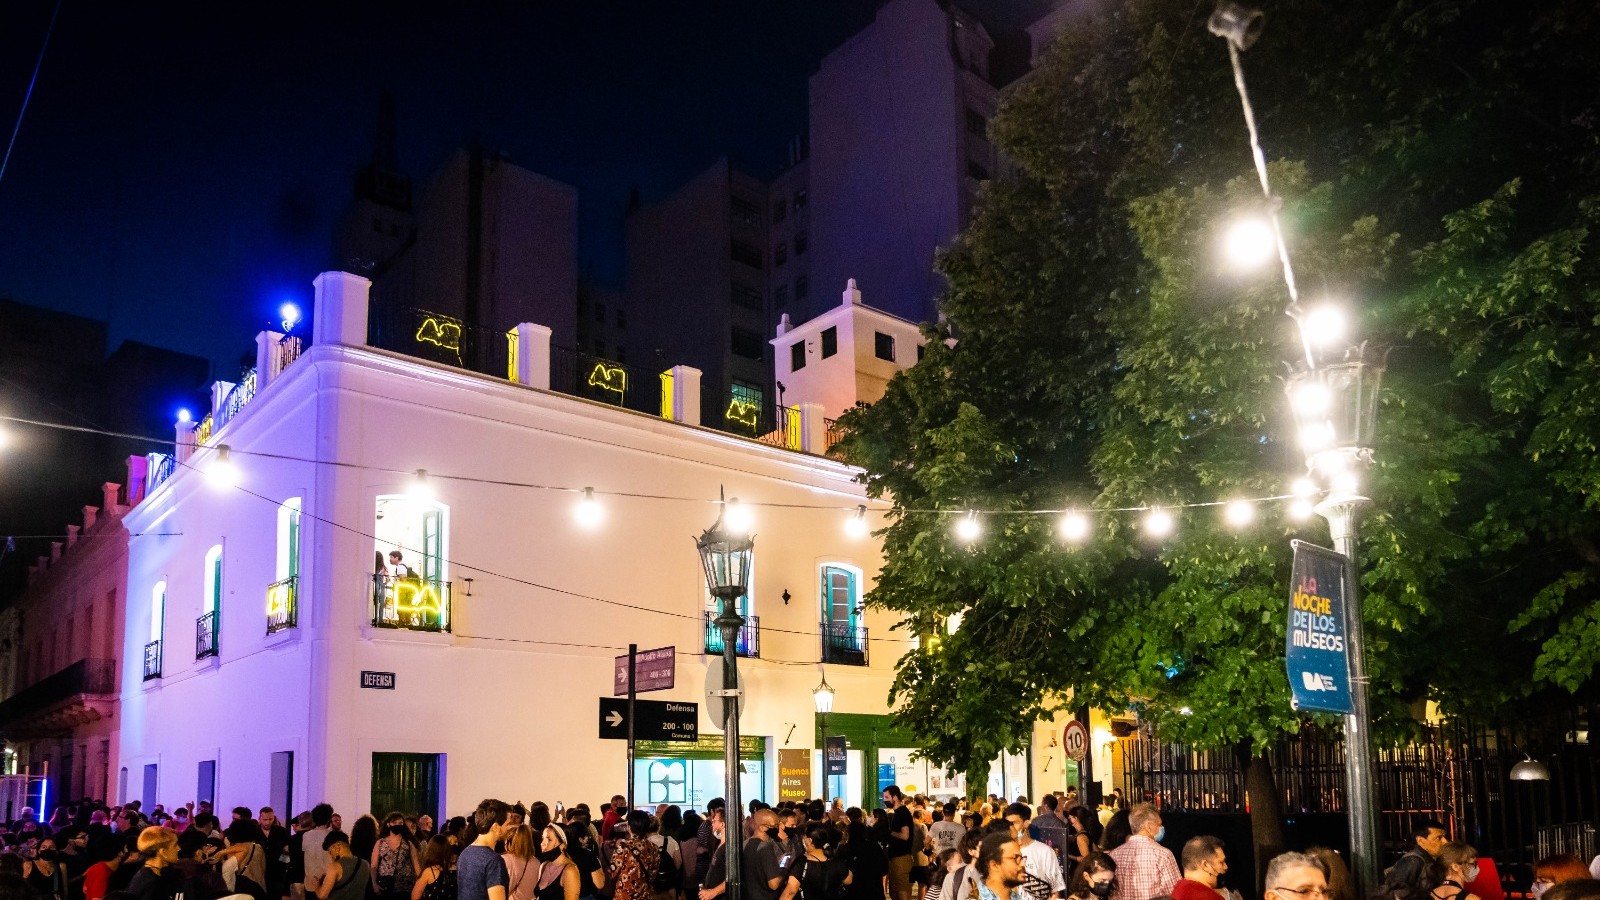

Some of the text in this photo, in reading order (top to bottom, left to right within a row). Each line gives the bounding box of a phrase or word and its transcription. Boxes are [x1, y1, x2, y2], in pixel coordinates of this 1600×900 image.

[1302, 576, 1317, 594] LA
[1293, 584, 1332, 617] NOCHE
[1294, 610, 1336, 632] DE LOS
[1293, 614, 1344, 652] MUSEOS
[364, 673, 393, 687] DEFENSA
[666, 703, 695, 712] Defensa
[662, 722, 676, 730] 200
[682, 722, 695, 731] 100
[1068, 731, 1082, 750] 10
[781, 767, 809, 776] Buenos
[782, 778, 801, 786] Aires
[781, 789, 806, 797] Museo
